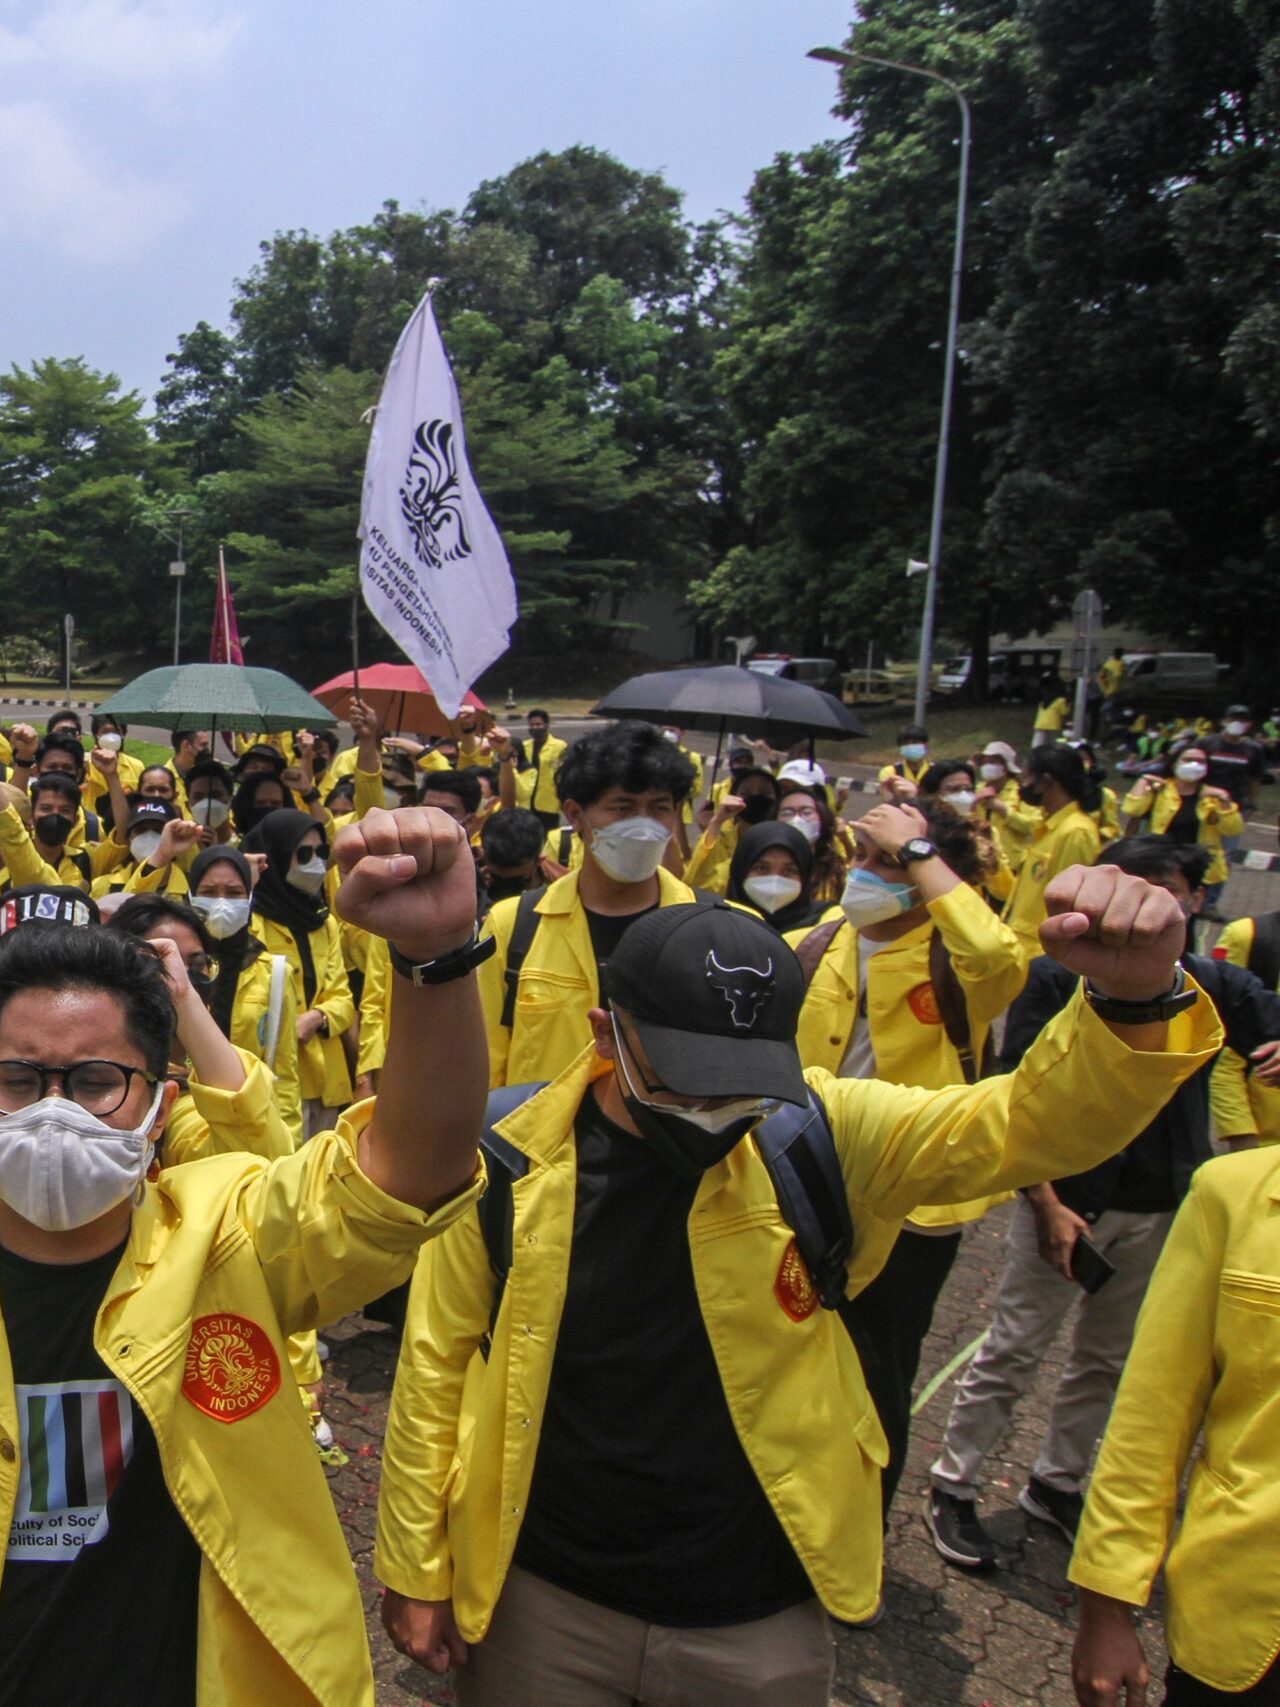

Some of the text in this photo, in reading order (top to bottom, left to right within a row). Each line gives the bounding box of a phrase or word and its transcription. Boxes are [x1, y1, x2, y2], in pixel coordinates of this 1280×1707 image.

[394, 597, 443, 659] INDONESIA
[137, 801, 166, 814] FILA
[186, 1319, 253, 1382] UNIVERSITAS
[209, 1358, 272, 1411] INDONESIA
[48, 1515, 64, 1528] of
